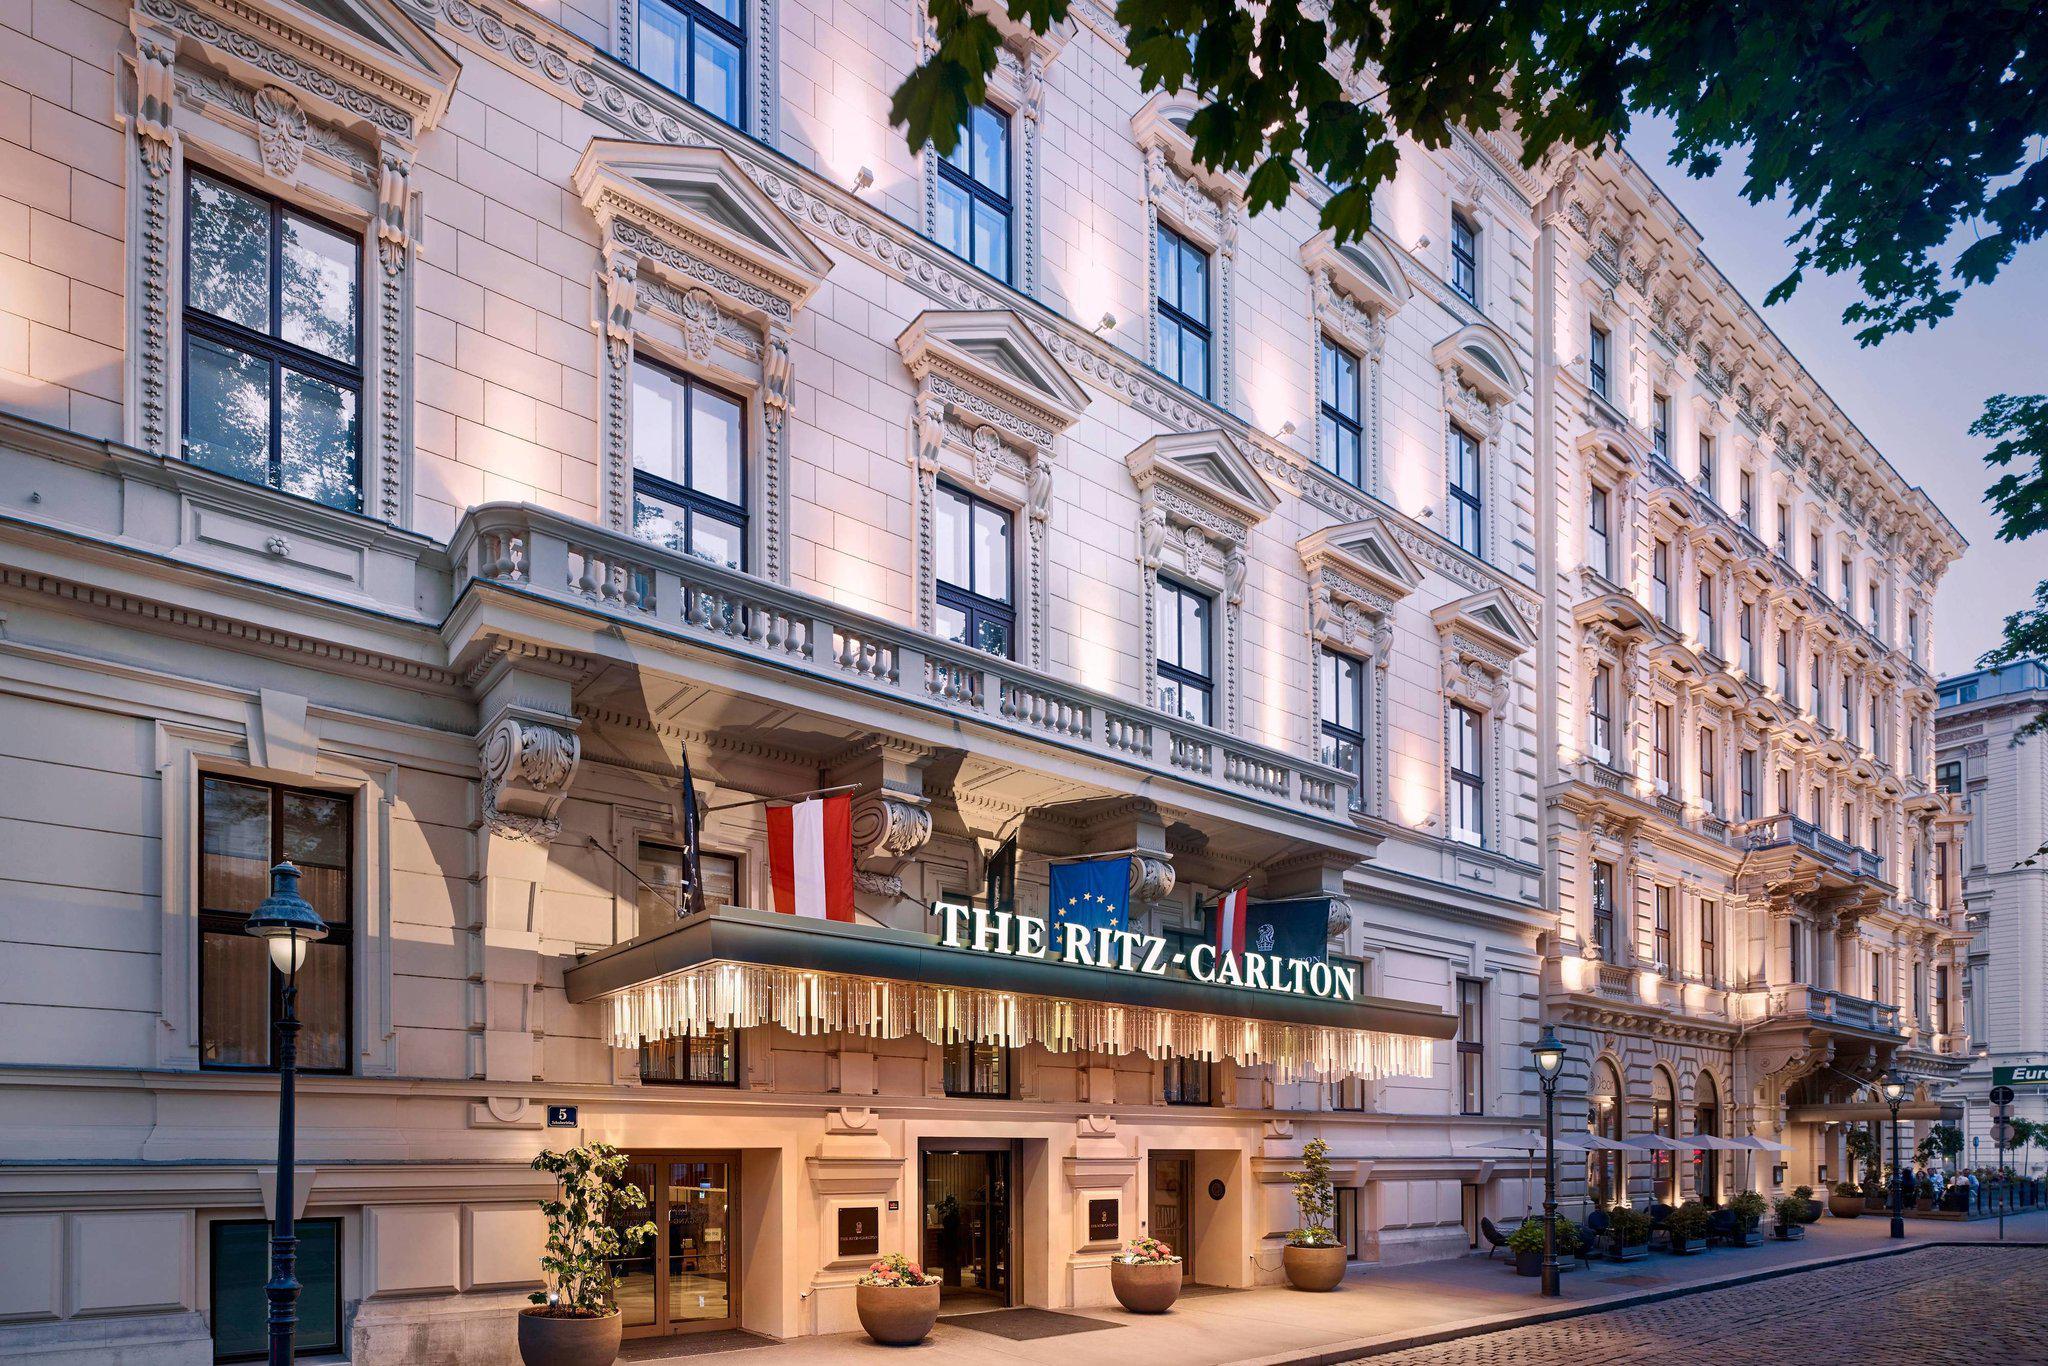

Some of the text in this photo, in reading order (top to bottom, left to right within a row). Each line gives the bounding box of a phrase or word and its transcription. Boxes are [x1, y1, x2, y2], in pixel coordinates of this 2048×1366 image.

[932, 901, 1356, 1001] THE RITZ-CARLTON
[559, 1108, 567, 1120] 5
